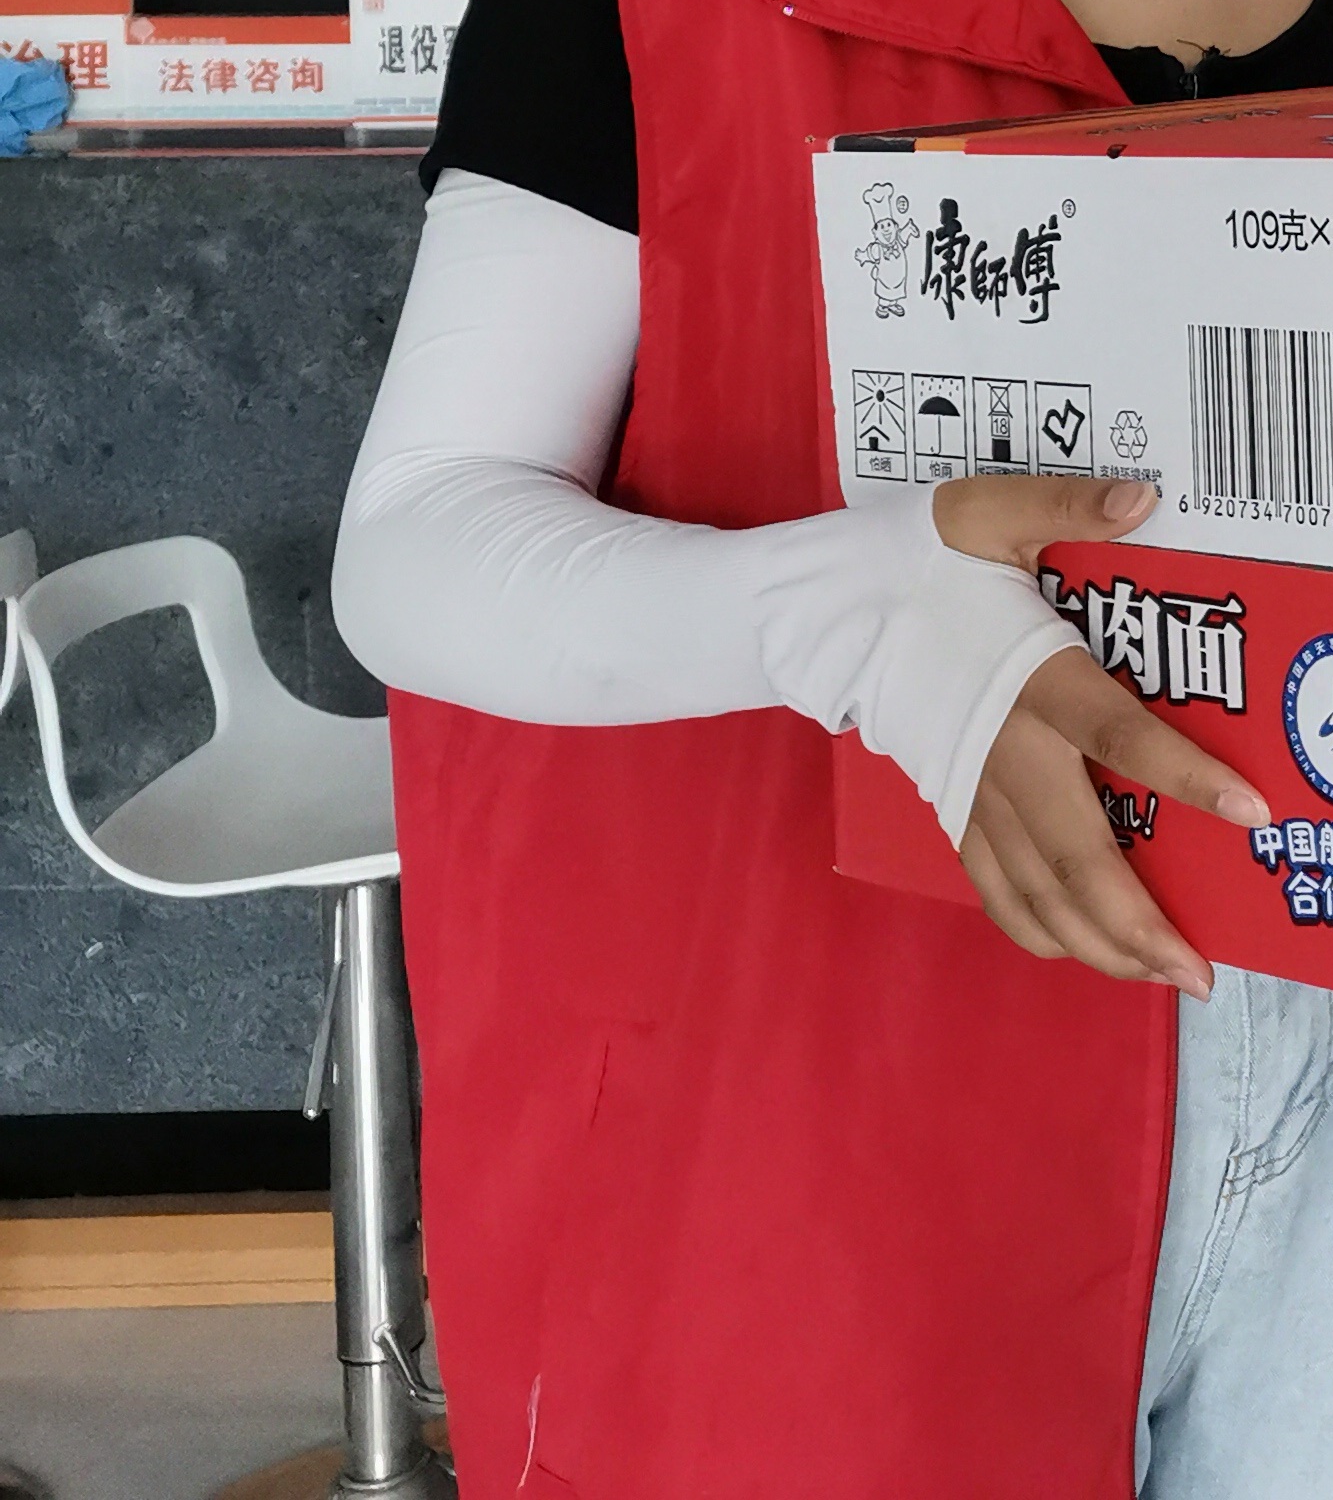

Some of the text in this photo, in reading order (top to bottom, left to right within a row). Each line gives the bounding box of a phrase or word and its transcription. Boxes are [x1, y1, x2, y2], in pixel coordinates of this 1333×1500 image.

[158, 57, 325, 94] 法律咨询
[1201, 498, 1273, 523] 920734
